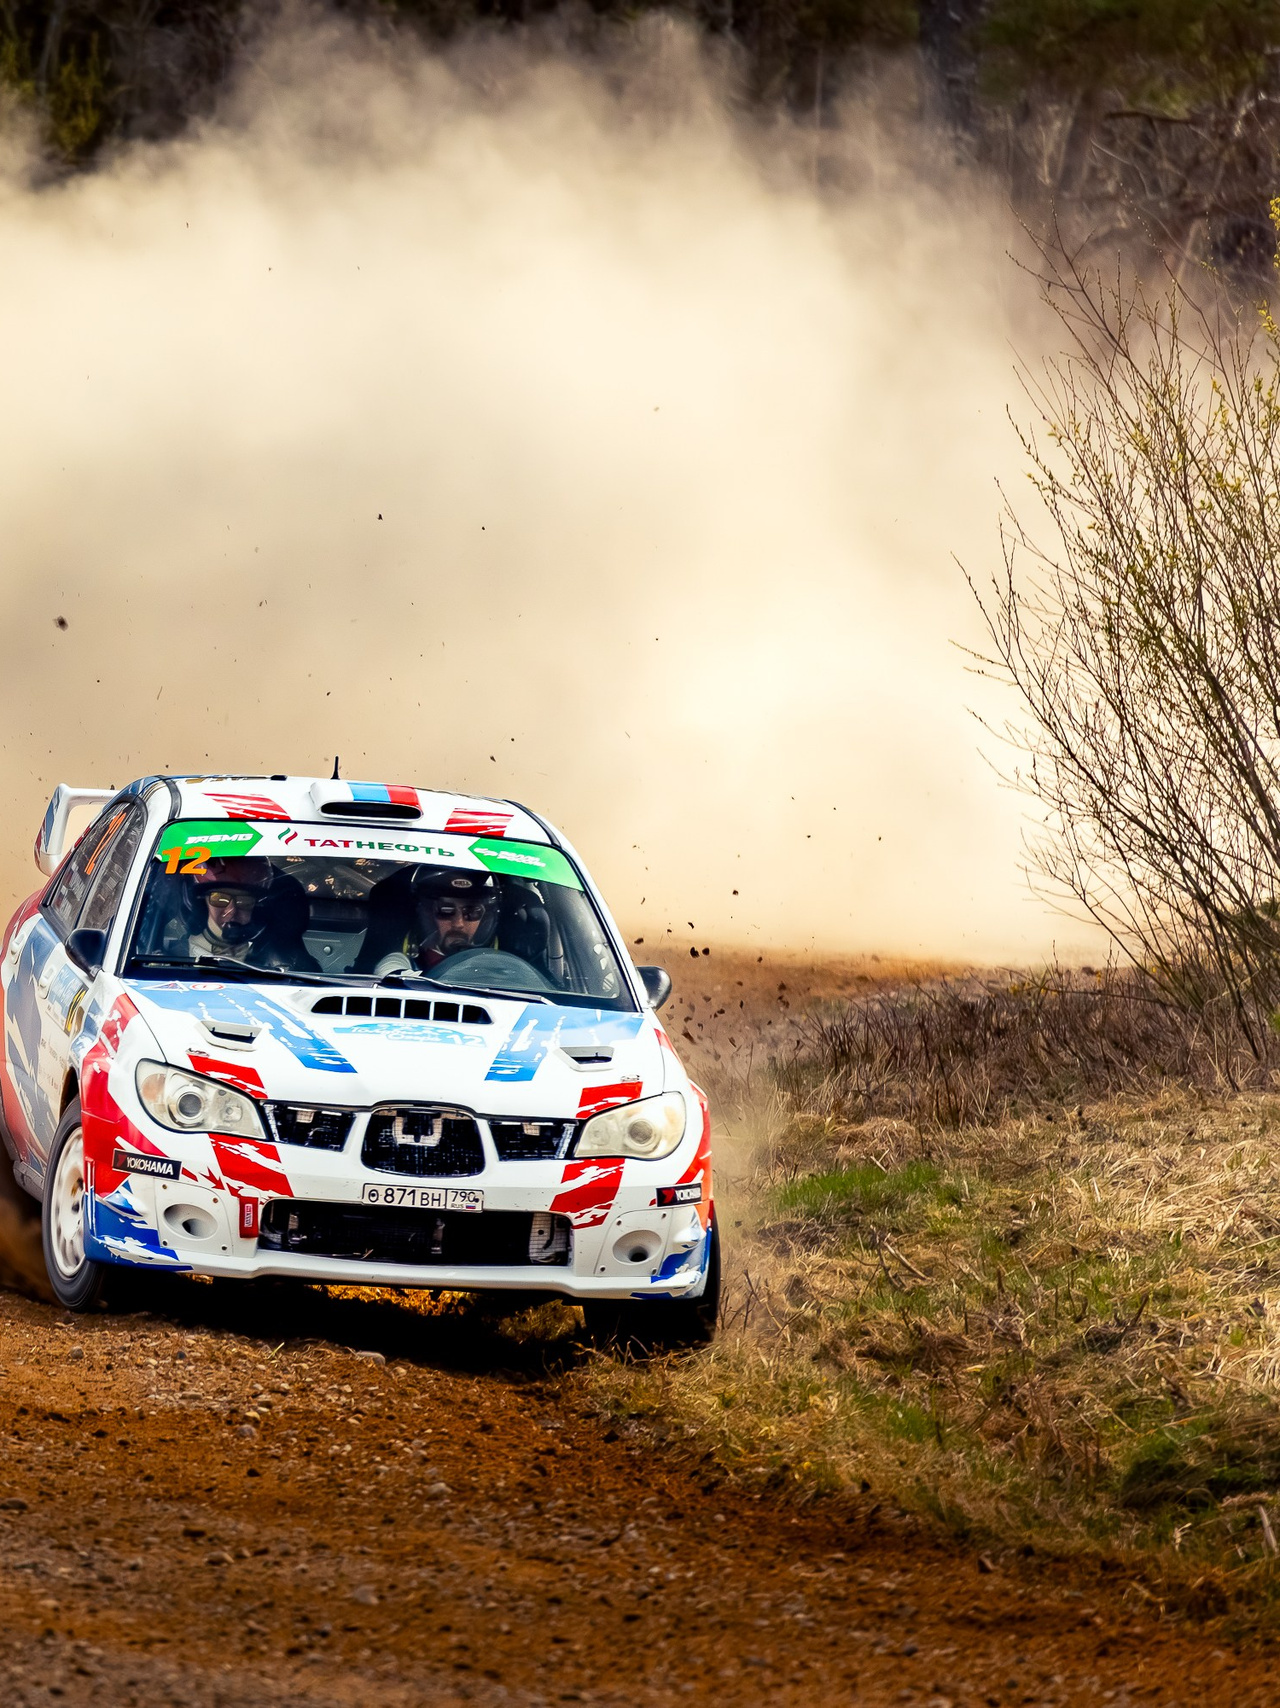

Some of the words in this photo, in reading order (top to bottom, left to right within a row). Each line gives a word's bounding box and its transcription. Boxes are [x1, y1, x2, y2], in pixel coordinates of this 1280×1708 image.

[304, 838, 455, 857] ТАТНЕФТЬ
[162, 846, 212, 875] 12
[447, 1034, 482, 1046] 12
[126, 1156, 174, 1175] YOKOHAMA
